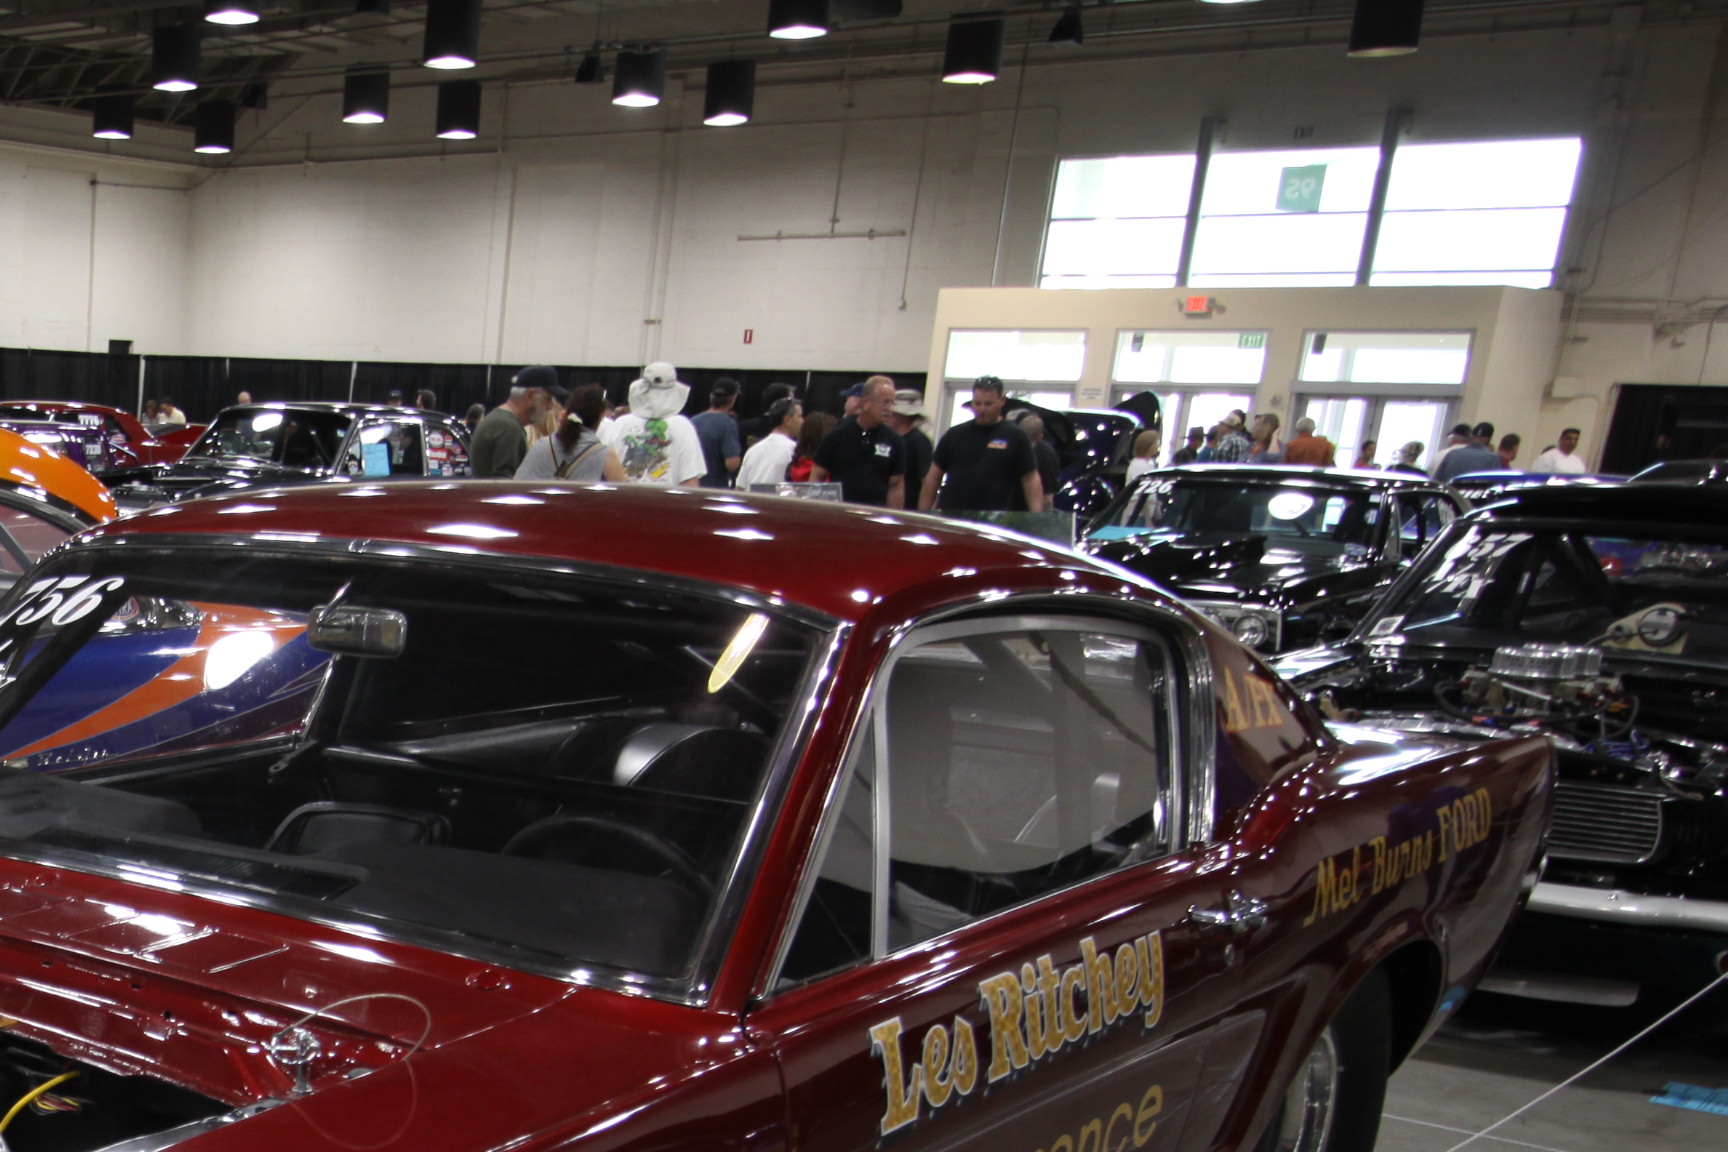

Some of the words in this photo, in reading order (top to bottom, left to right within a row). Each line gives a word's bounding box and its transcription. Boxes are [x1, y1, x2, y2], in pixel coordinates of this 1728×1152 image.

[1302, 845, 1360, 928] Mel
[1368, 829, 1433, 896] Burns
[1435, 787, 1492, 864] FORD
[868, 1014, 978, 1138] Les
[977, 929, 1165, 1086] Ritchey
